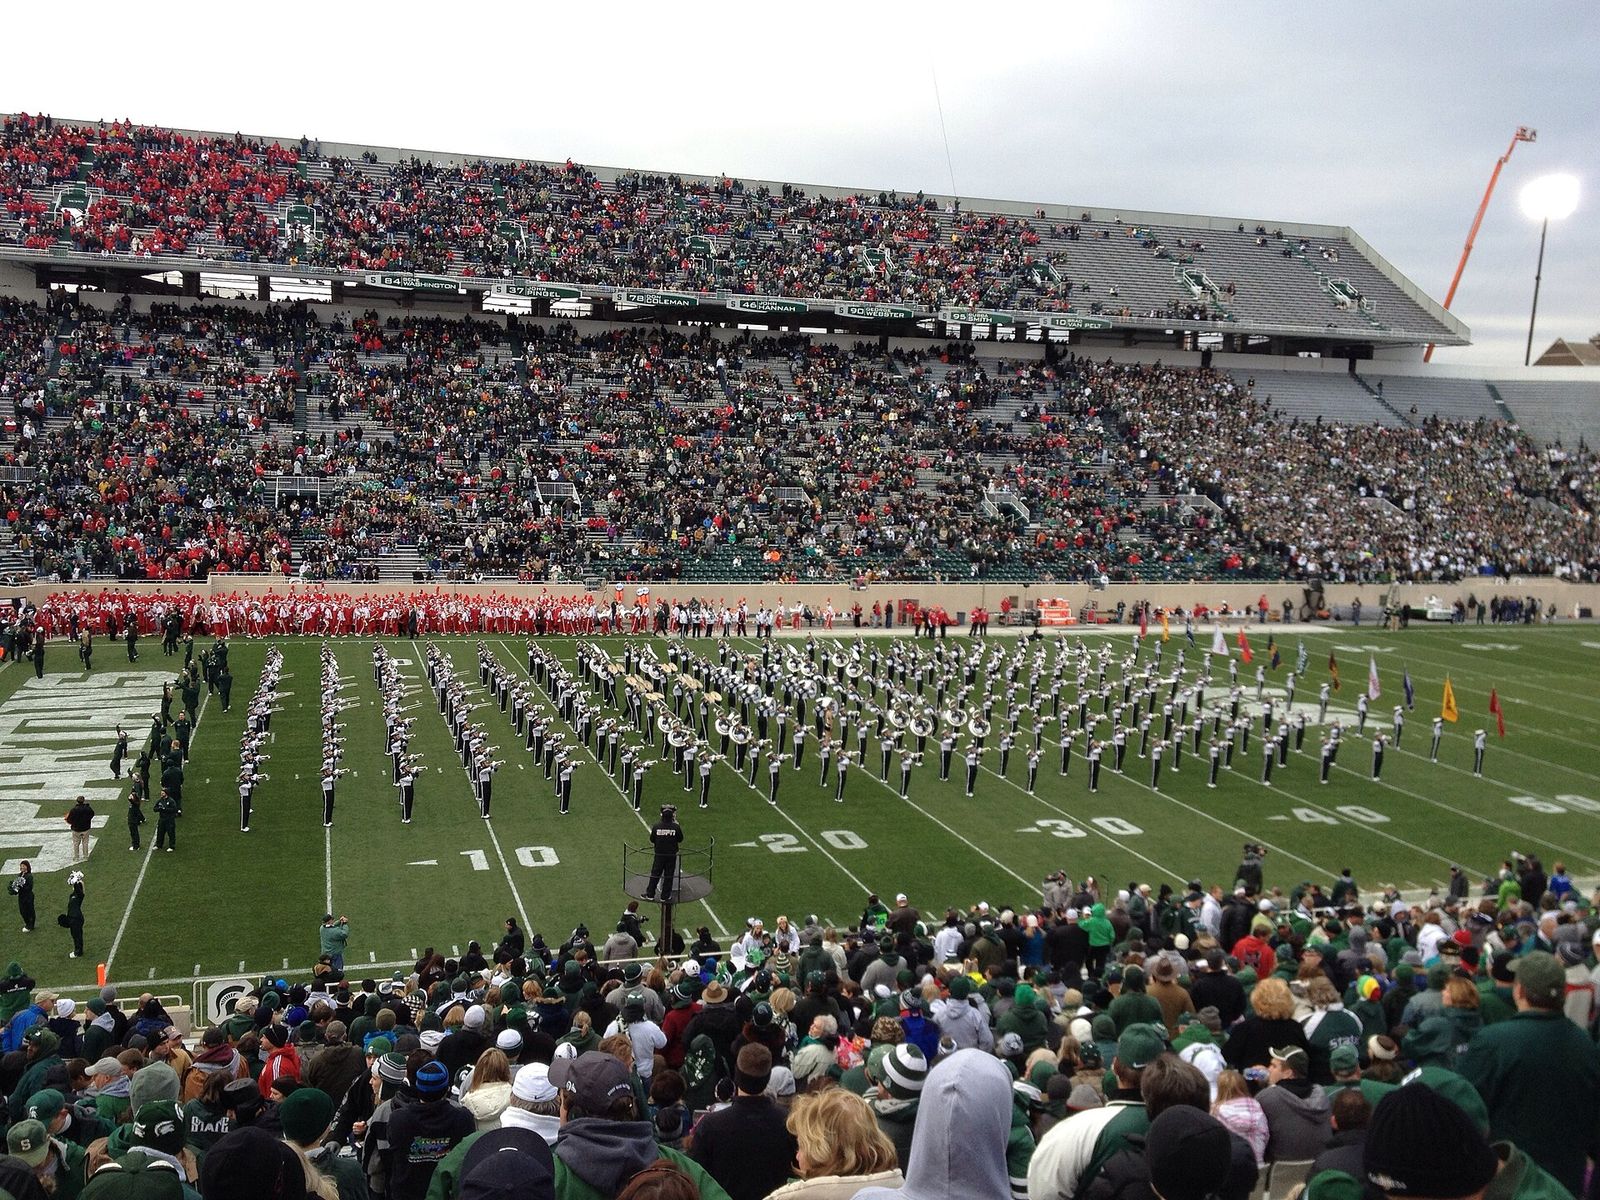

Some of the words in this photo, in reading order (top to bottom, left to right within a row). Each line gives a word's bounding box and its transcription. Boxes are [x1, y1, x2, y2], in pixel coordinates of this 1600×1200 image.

[384, 277, 401, 286] 84
[402, 281, 457, 289] WASHINGTON
[508, 286, 524, 295] 37
[629, 294, 644, 302] 78
[646, 298, 690, 306] COLEMAN
[742, 301, 757, 309] 46
[850, 307, 864, 315] 90
[1035, 816, 1145, 839] 30
[759, 830, 869, 854] 20
[460, 846, 560, 871] 10
[20, 1138, 31, 1151] S
